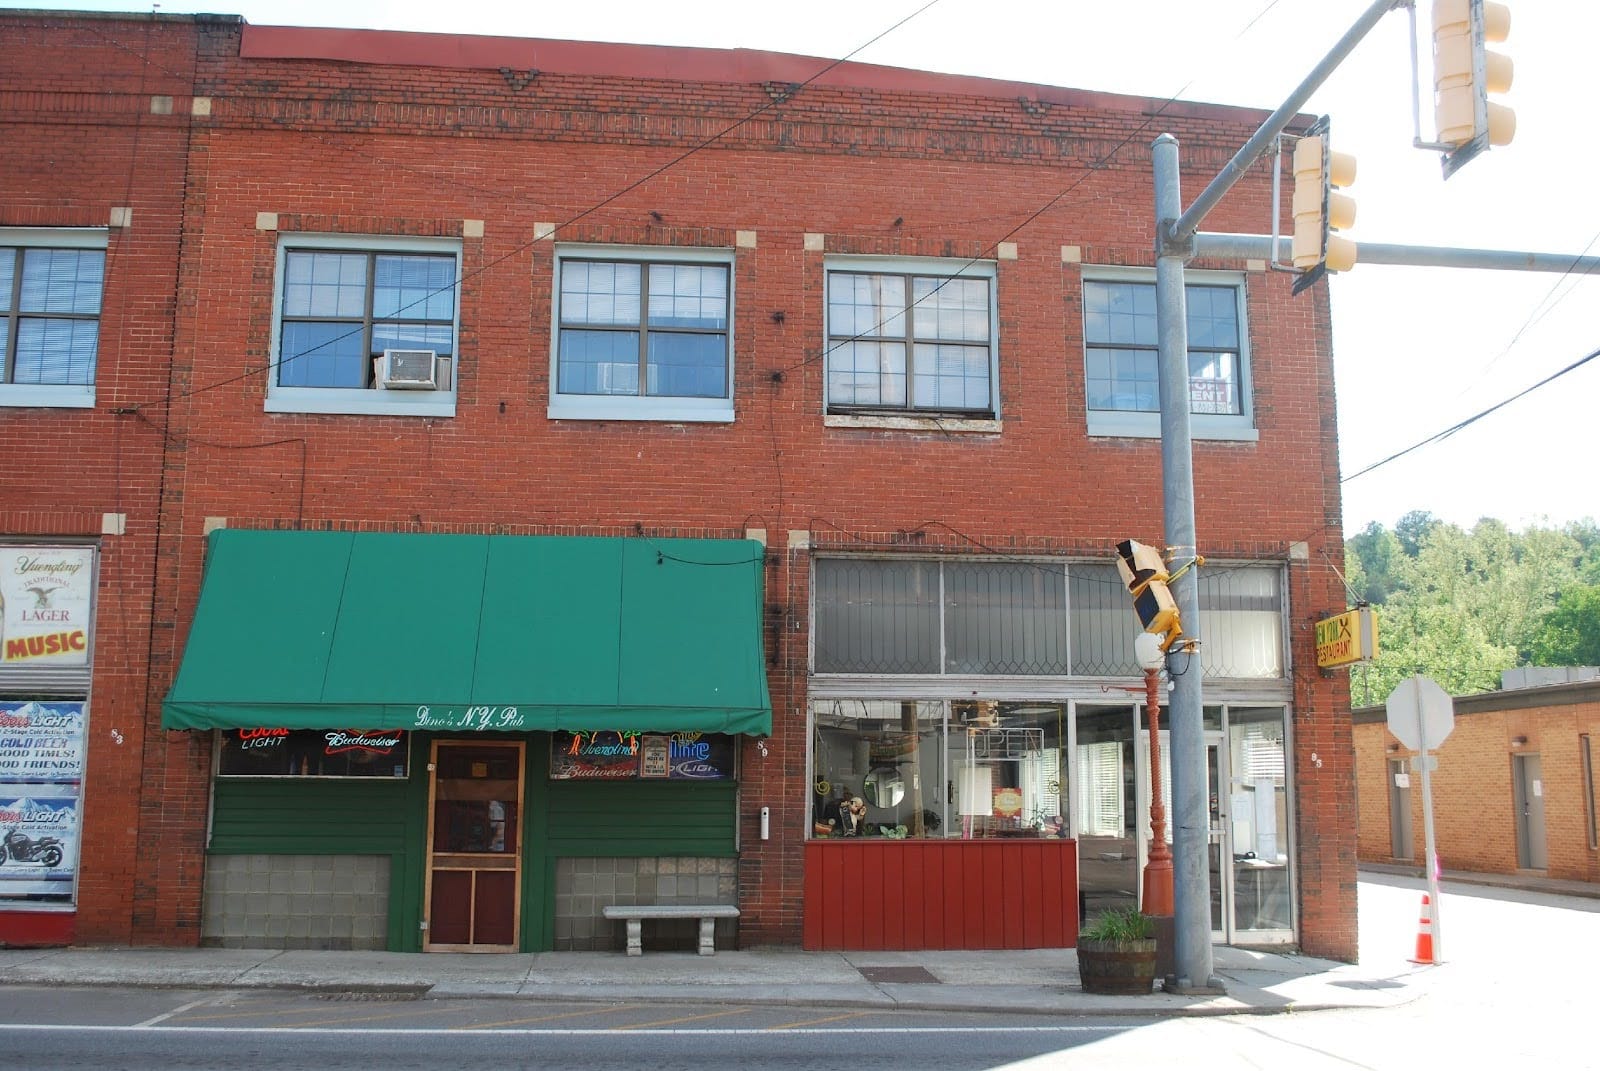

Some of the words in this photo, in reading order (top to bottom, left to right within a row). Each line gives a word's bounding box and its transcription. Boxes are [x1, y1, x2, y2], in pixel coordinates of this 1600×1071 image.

[1190, 390, 1225, 401] ENT
[15, 555, 84, 575] Yuengling
[24, 577, 70, 588] TRADITIONAL
[22, 609, 70, 622] LAGER
[6, 630, 86, 660] MUSIC
[31, 715, 74, 728] LIGHT
[415, 705, 454, 727] Dino's
[496, 706, 524, 727] Pub
[111, 728, 123, 744] 83
[325, 732, 400, 747] Budweiser
[1, 737, 33, 749] COLD
[34, 737, 68, 749] BEER
[241, 736, 287, 750] LIGHT
[972, 729, 1043, 758] OPEN
[35, 749, 76, 758] TIMES!
[24, 759, 81, 769] FRIENDS!
[22, 811, 66, 823] LIGHT
